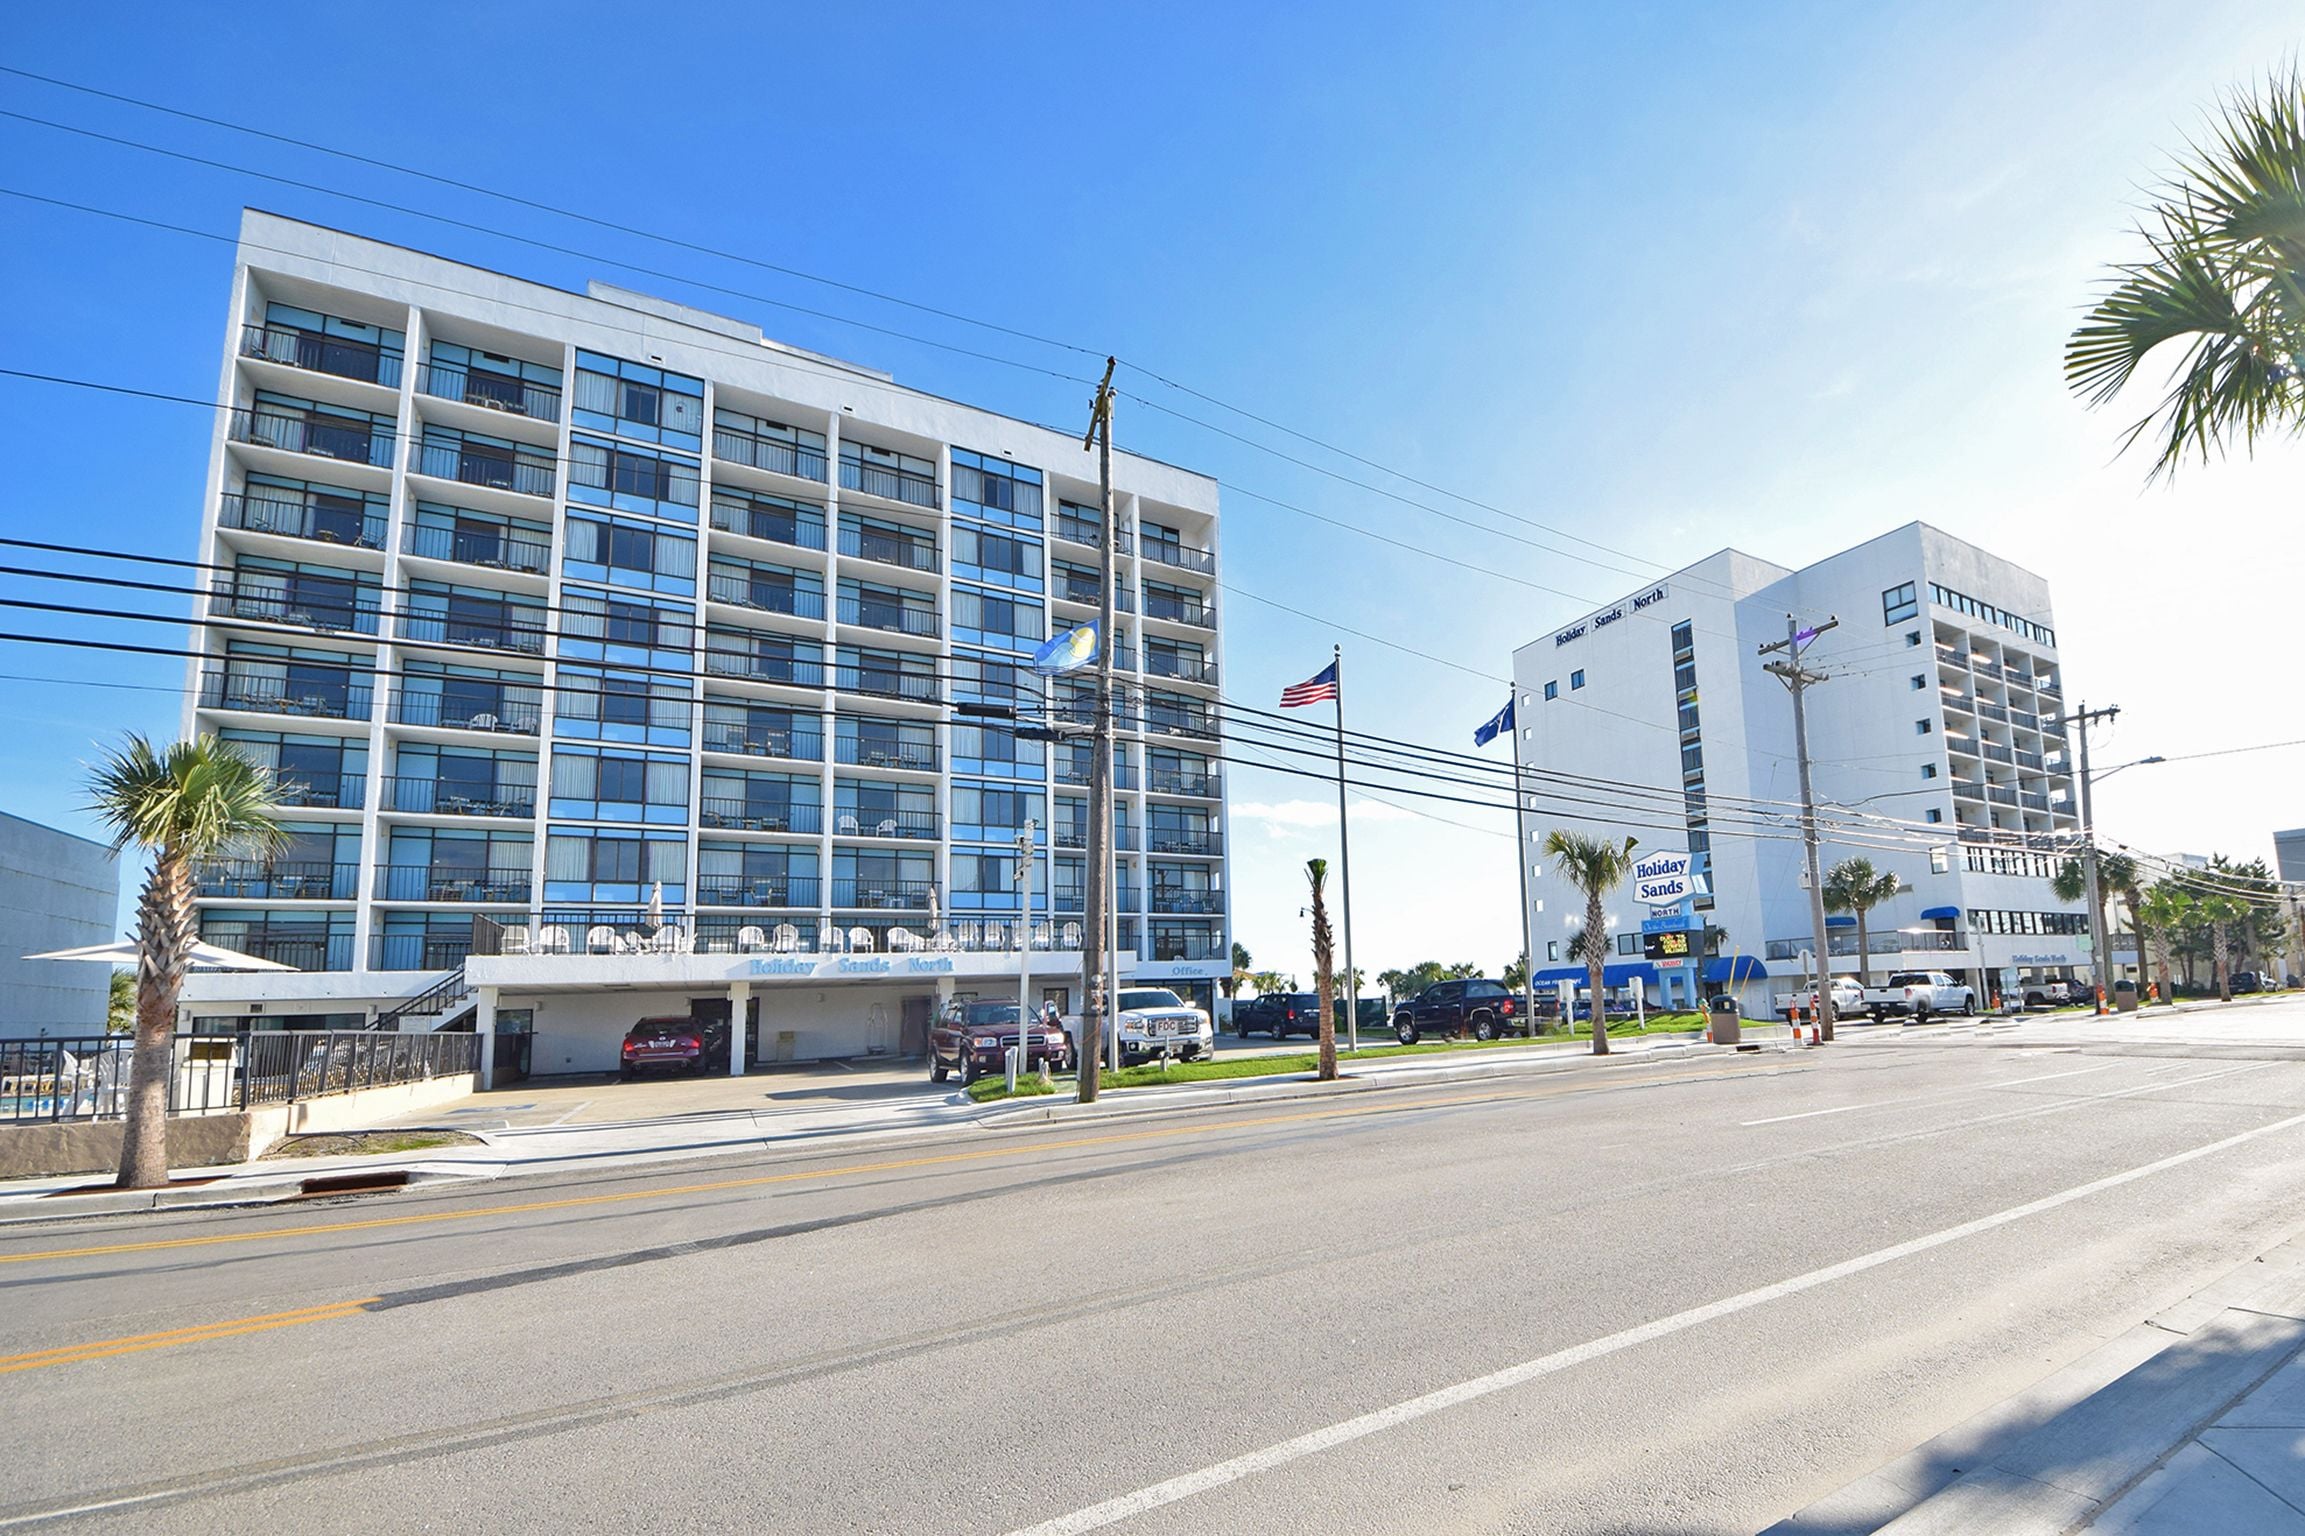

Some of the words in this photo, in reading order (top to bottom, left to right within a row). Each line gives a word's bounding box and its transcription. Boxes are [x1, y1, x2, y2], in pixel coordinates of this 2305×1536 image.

[1555, 624, 1586, 648] Holiday
[1594, 608, 1622, 628] Sands
[1633, 588, 1664, 611] North
[1636, 859, 1687, 879] Holiday
[1641, 880, 1684, 898] Sands
[1651, 907, 1680, 917] NORTH
[750, 959, 817, 975] Holiday
[838, 957, 890, 973] Sands
[909, 957, 954, 972] North
[1172, 966, 1203, 976] Office
[1158, 1021, 1176, 1031] FDC
